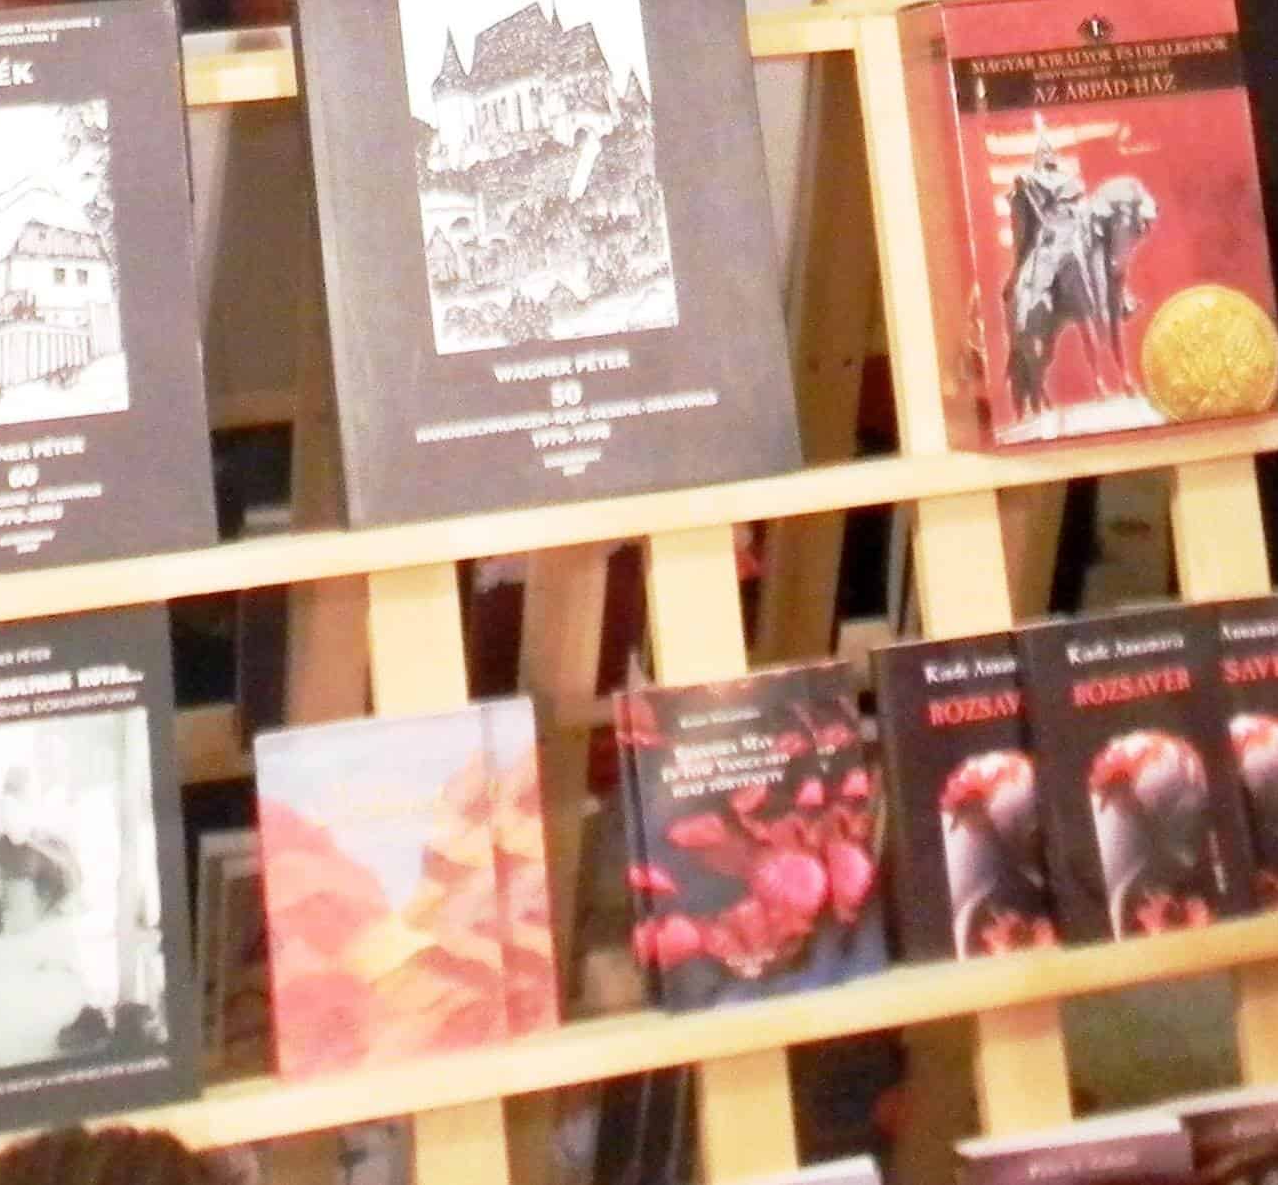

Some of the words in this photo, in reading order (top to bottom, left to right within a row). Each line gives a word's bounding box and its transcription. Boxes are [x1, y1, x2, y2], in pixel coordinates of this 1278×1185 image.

[971, 54, 1036, 76] MAGYAR
[1034, 85, 1060, 103] AZ
[494, 358, 572, 383] WAGNER
[574, 347, 630, 374] PÉTER
[550, 379, 583, 408] 50
